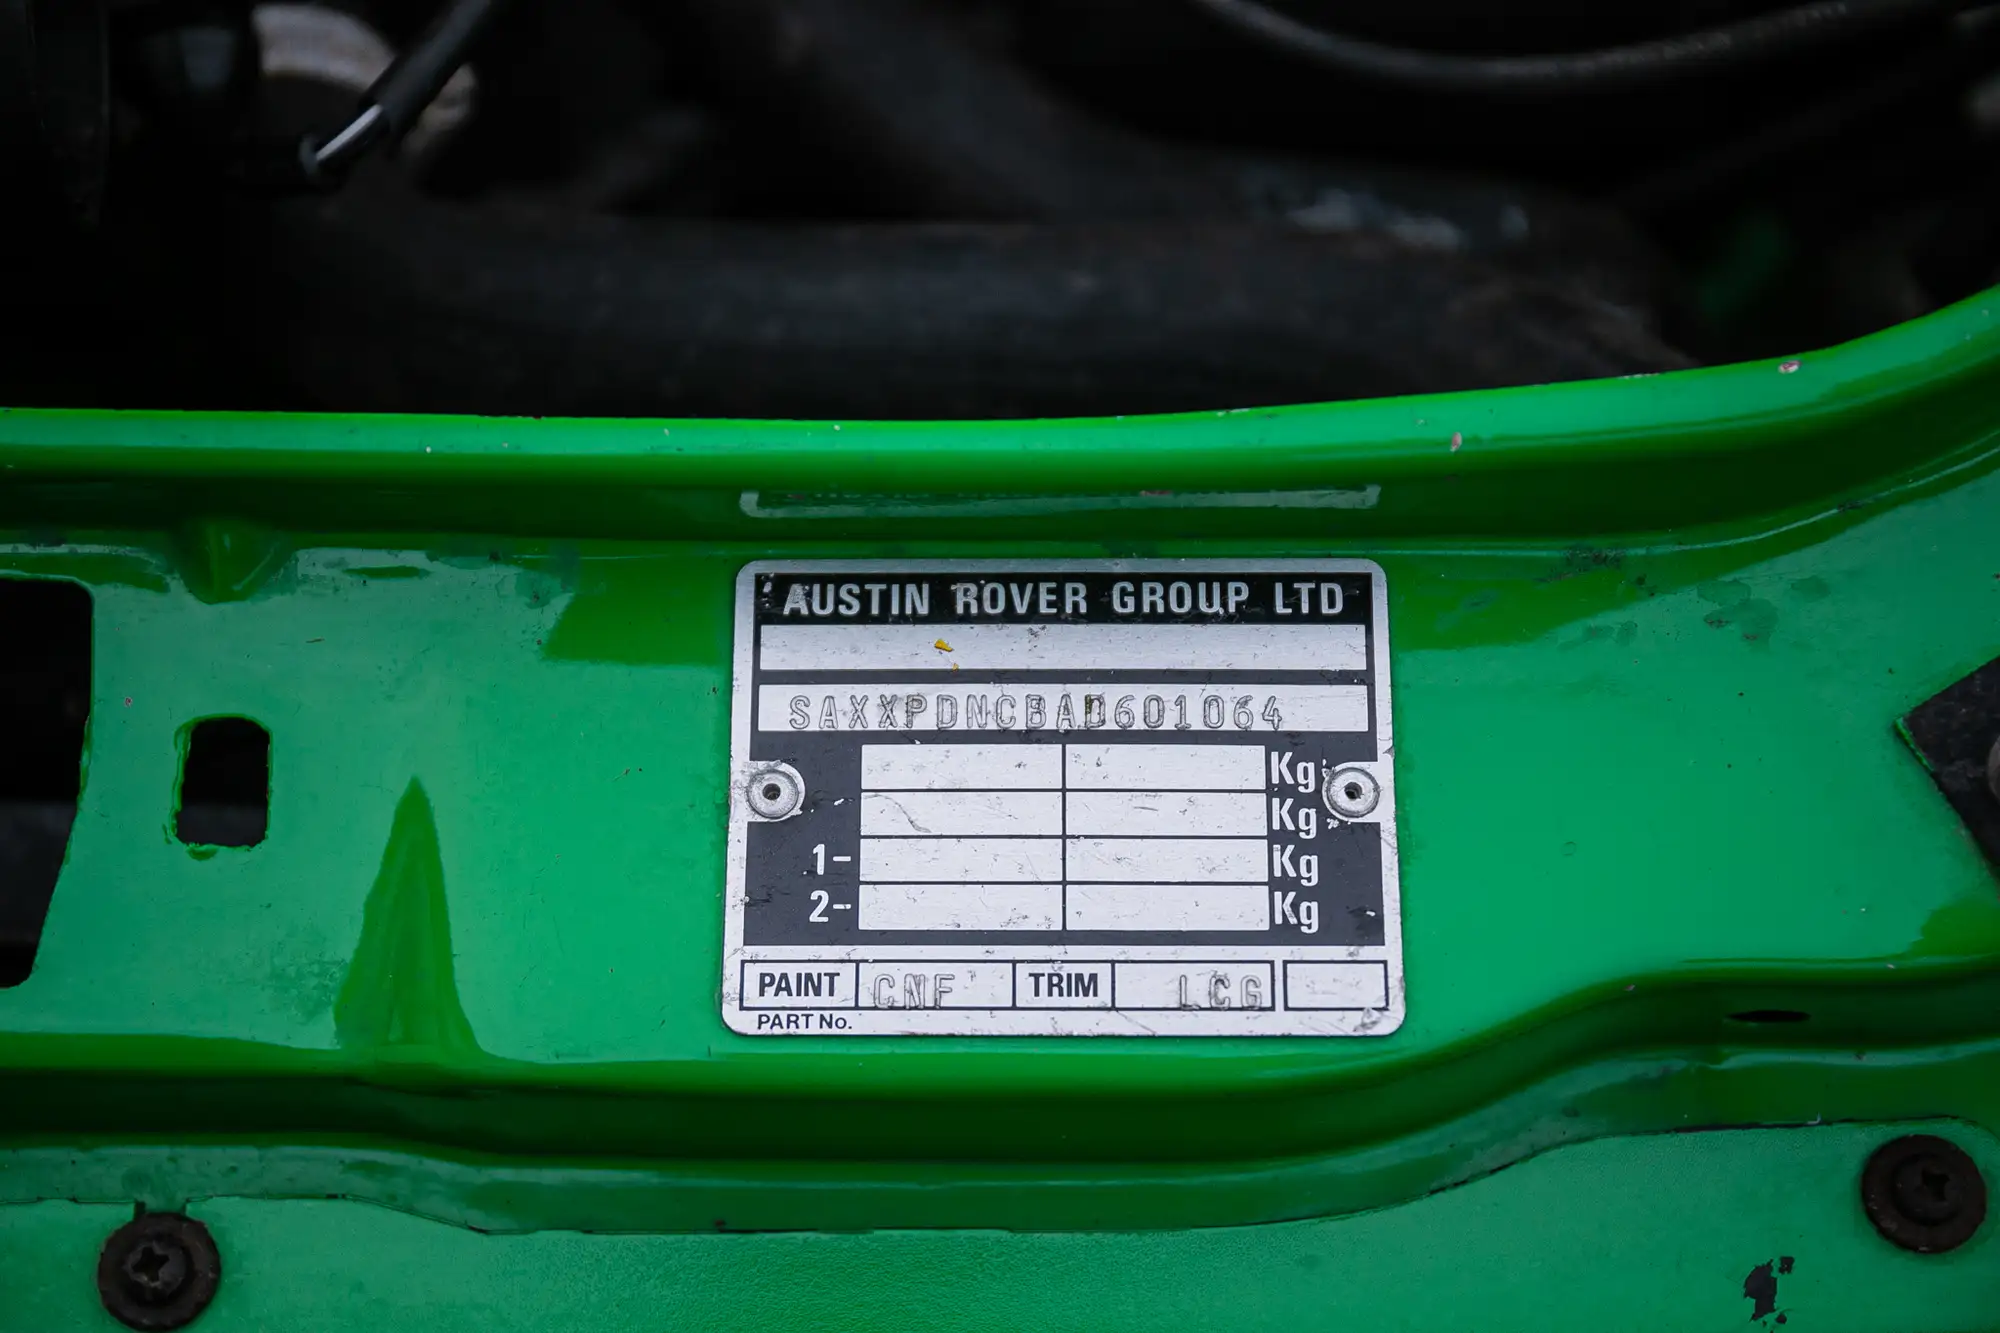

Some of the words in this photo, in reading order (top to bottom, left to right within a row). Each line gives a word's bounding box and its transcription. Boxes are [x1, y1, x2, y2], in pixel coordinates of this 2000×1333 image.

[783, 583, 930, 616] AUSTIN
[955, 582, 1087, 614] ROVER
[1112, 582, 1249, 614] GROUP
[1275, 582, 1344, 614] LTD
[789, 694, 1283, 731] SAXXPDNCBAD601064
[1270, 751, 1315, 792] Kg
[1271, 798, 1317, 839] Kg
[1272, 844, 1319, 885] Kg
[1273, 891, 1320, 933] Kg
[758, 973, 840, 998] PAINT
[873, 973, 955, 1009] CNF
[1029, 973, 1099, 998] TRIM
[1178, 974, 1263, 1010] LCG
[757, 1014, 813, 1030] PART
[819, 1014, 853, 1030] No.
